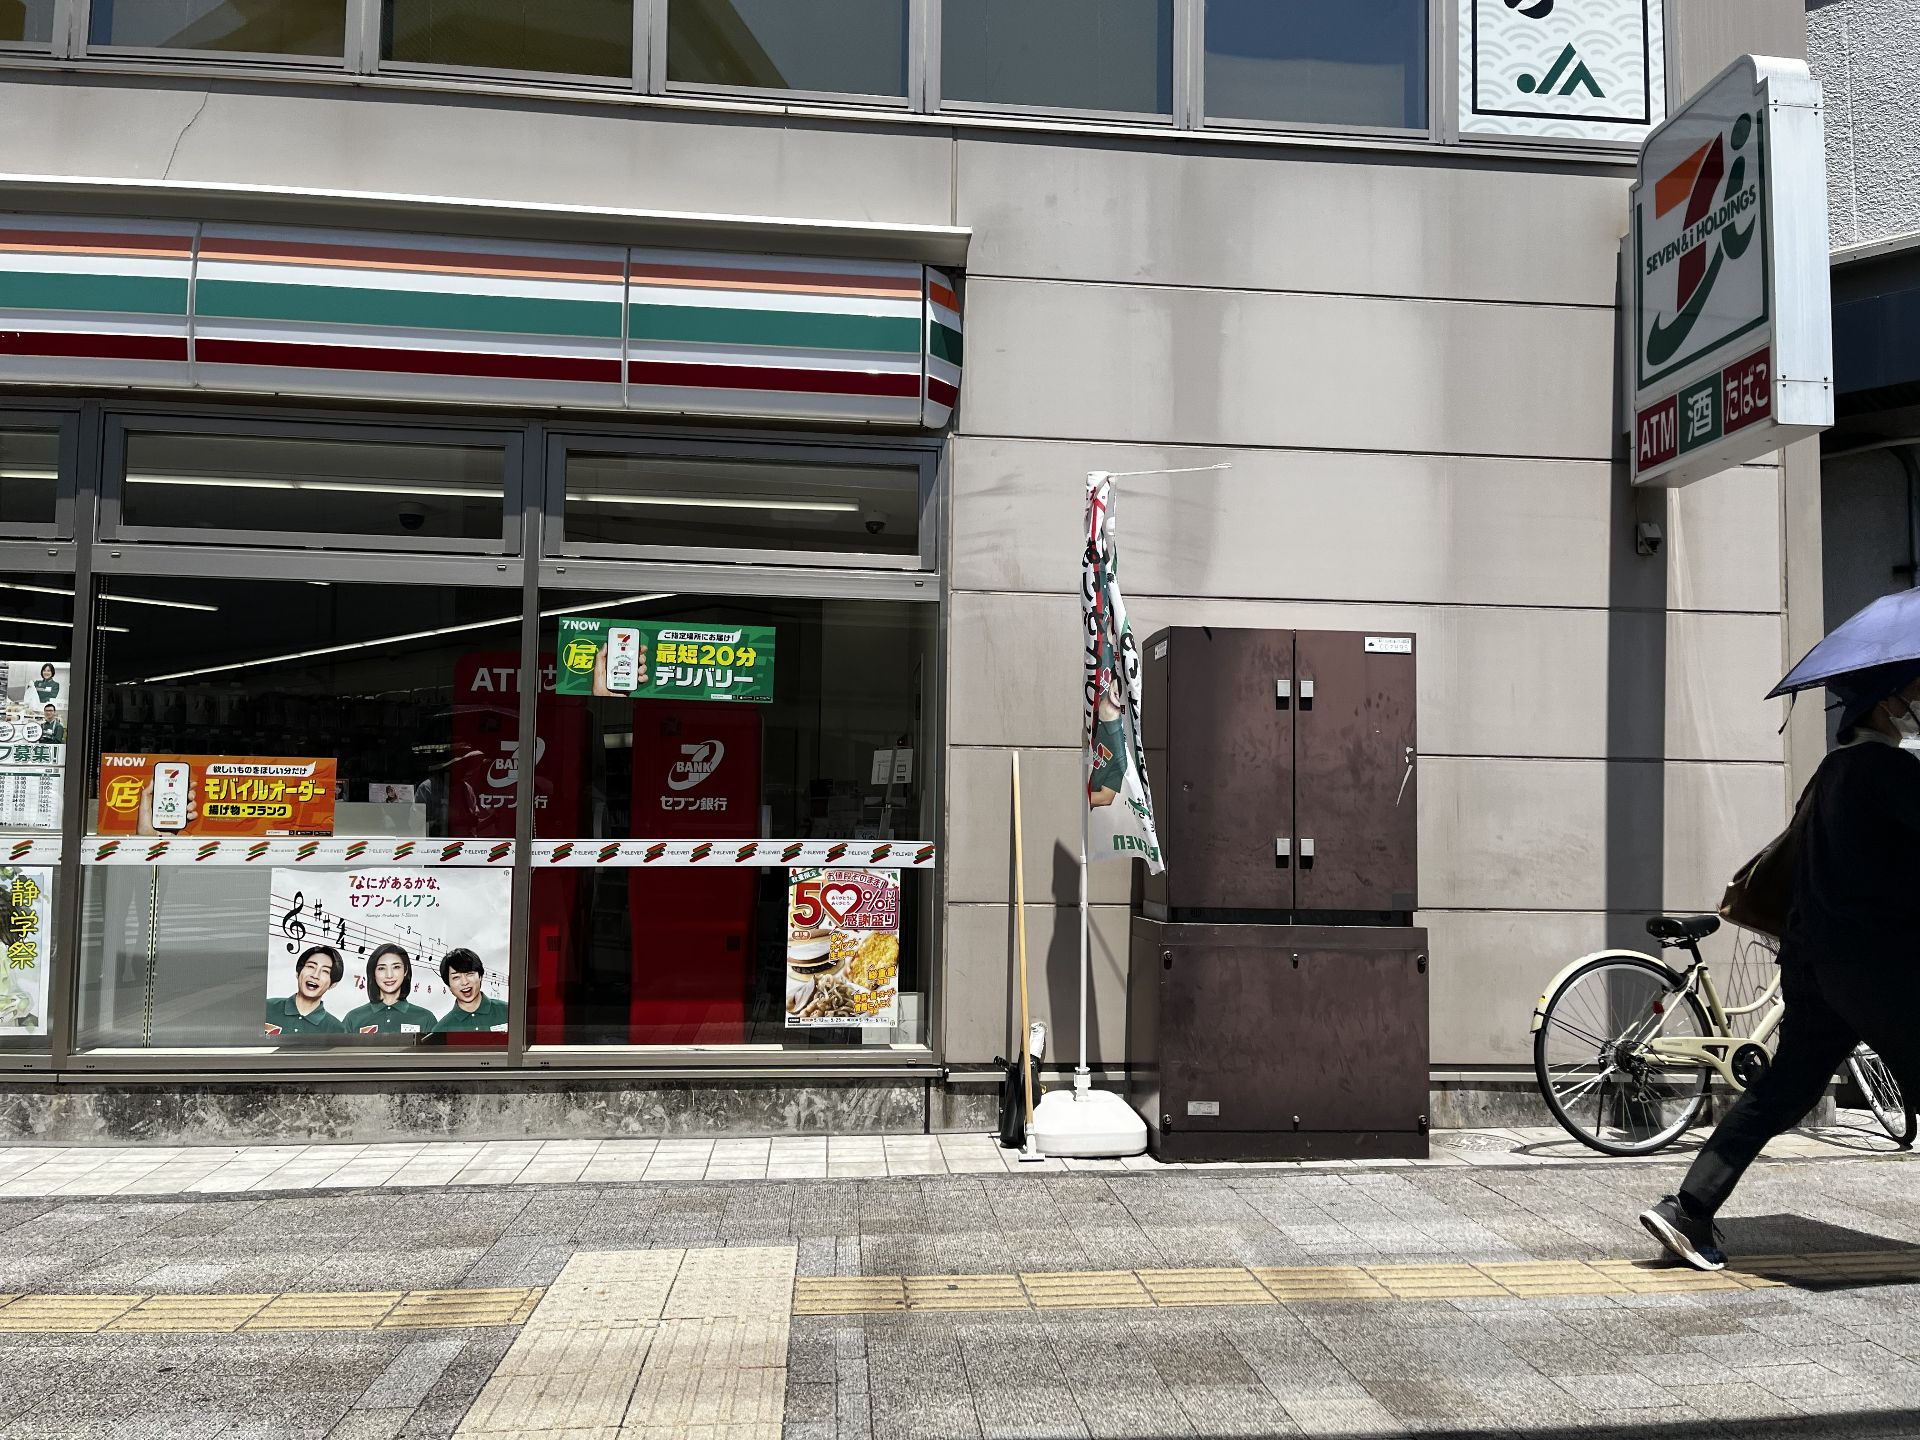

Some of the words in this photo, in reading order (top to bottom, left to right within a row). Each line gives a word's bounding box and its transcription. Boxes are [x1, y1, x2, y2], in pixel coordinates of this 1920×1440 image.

[1696, 184, 1757, 242] HOLDINGS
[1725, 362, 1769, 421] たばこ
[1687, 386, 1713, 443] 酒
[1639, 406, 1675, 463] ATM
[562, 620, 600, 631] 7NOW
[656, 643, 757, 668] 最短20分
[656, 665, 754, 688] デリバリー
[104, 756, 146, 767] 7NOW
[676, 761, 712, 773] BANK
[106, 779, 145, 808] 店
[204, 777, 326, 802] モバイルオーダー
[479, 793, 548, 809] セブン行
[660, 795, 728, 811] セブン銀行
[9, 879, 40, 970] 静学祭
